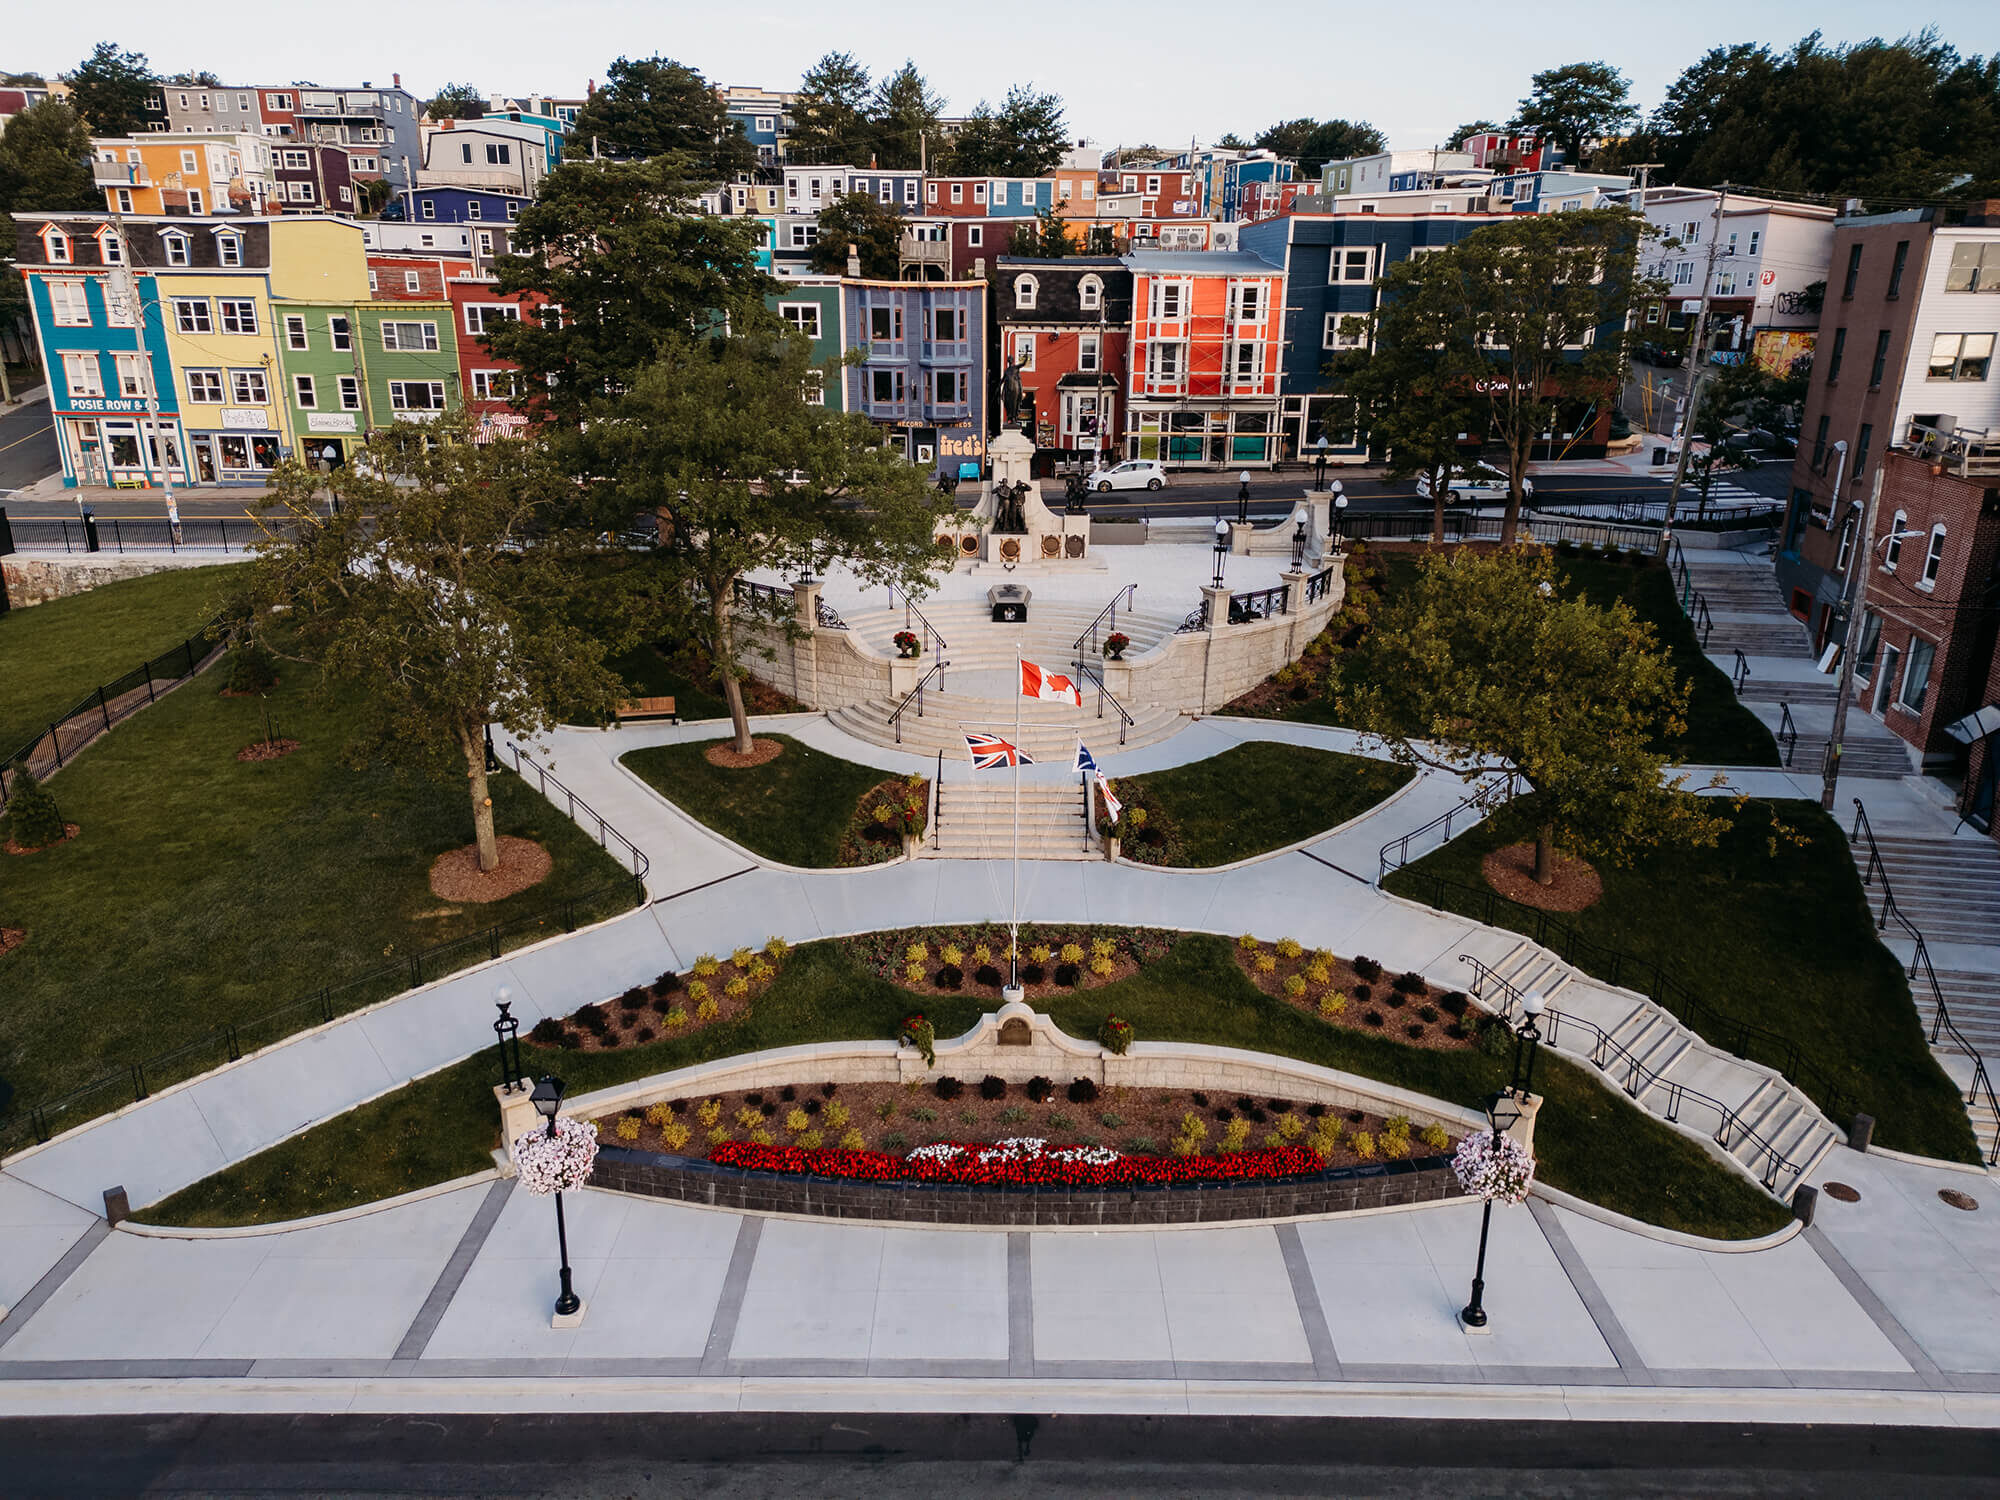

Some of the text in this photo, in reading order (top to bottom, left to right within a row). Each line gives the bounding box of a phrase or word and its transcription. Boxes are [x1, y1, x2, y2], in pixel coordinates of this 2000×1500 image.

[70, 400, 104, 410] POSIE
[106, 400, 131, 410] ROW
[135, 401, 142, 411] &
[940, 434, 982, 456] fred's
